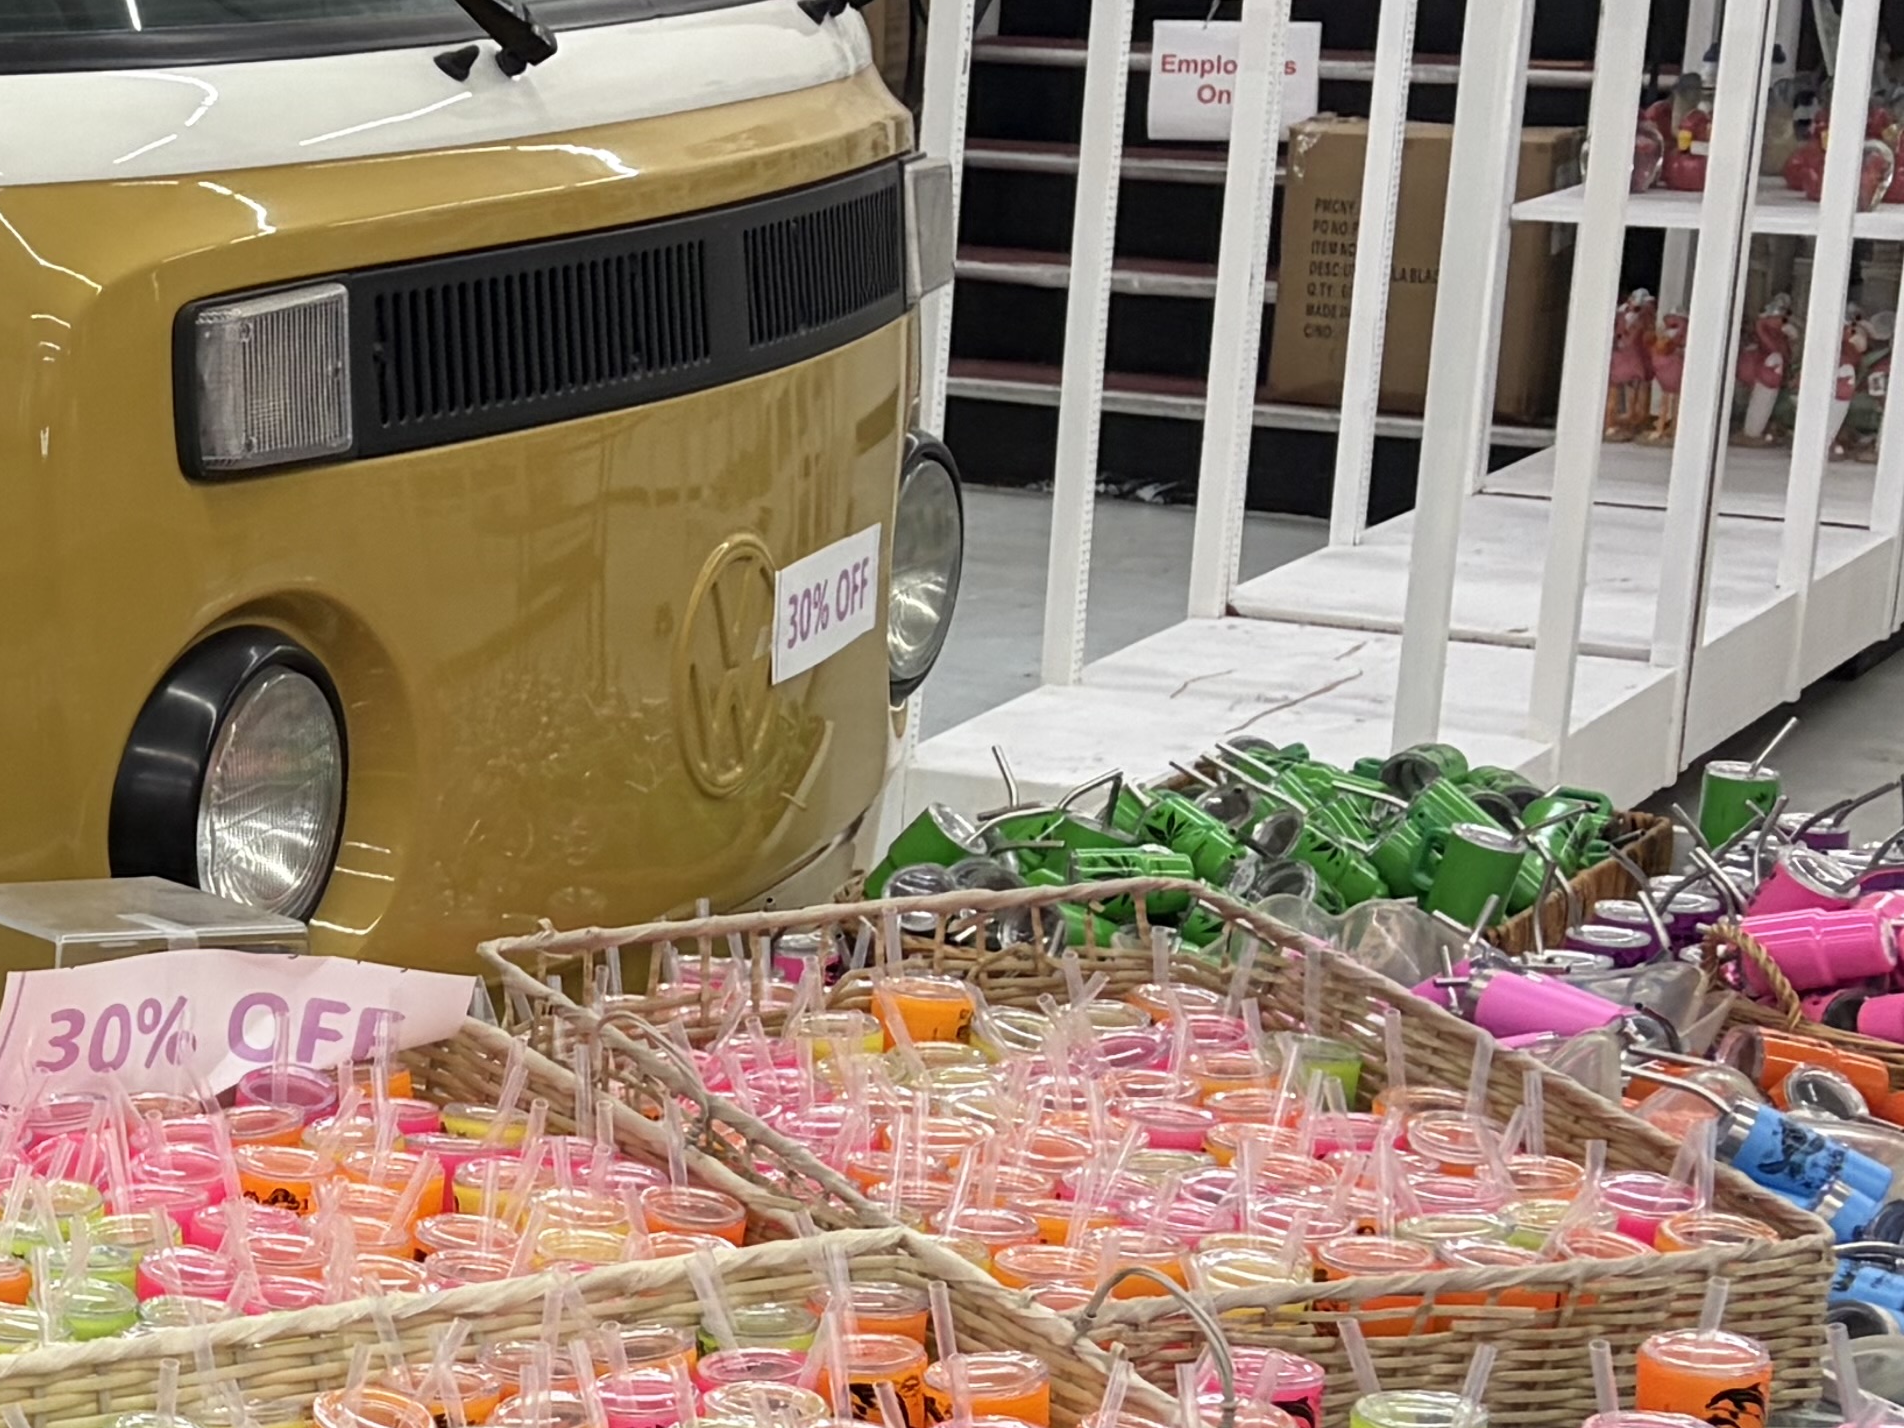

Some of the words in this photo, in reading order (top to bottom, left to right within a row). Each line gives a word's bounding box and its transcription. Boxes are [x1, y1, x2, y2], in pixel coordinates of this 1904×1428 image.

[1161, 54, 1297, 79] Emplos
[787, 579, 830, 650] 30%
[835, 556, 870, 622] OFF
[36, 995, 197, 1072] 30%
[227, 991, 405, 1064] OFF
